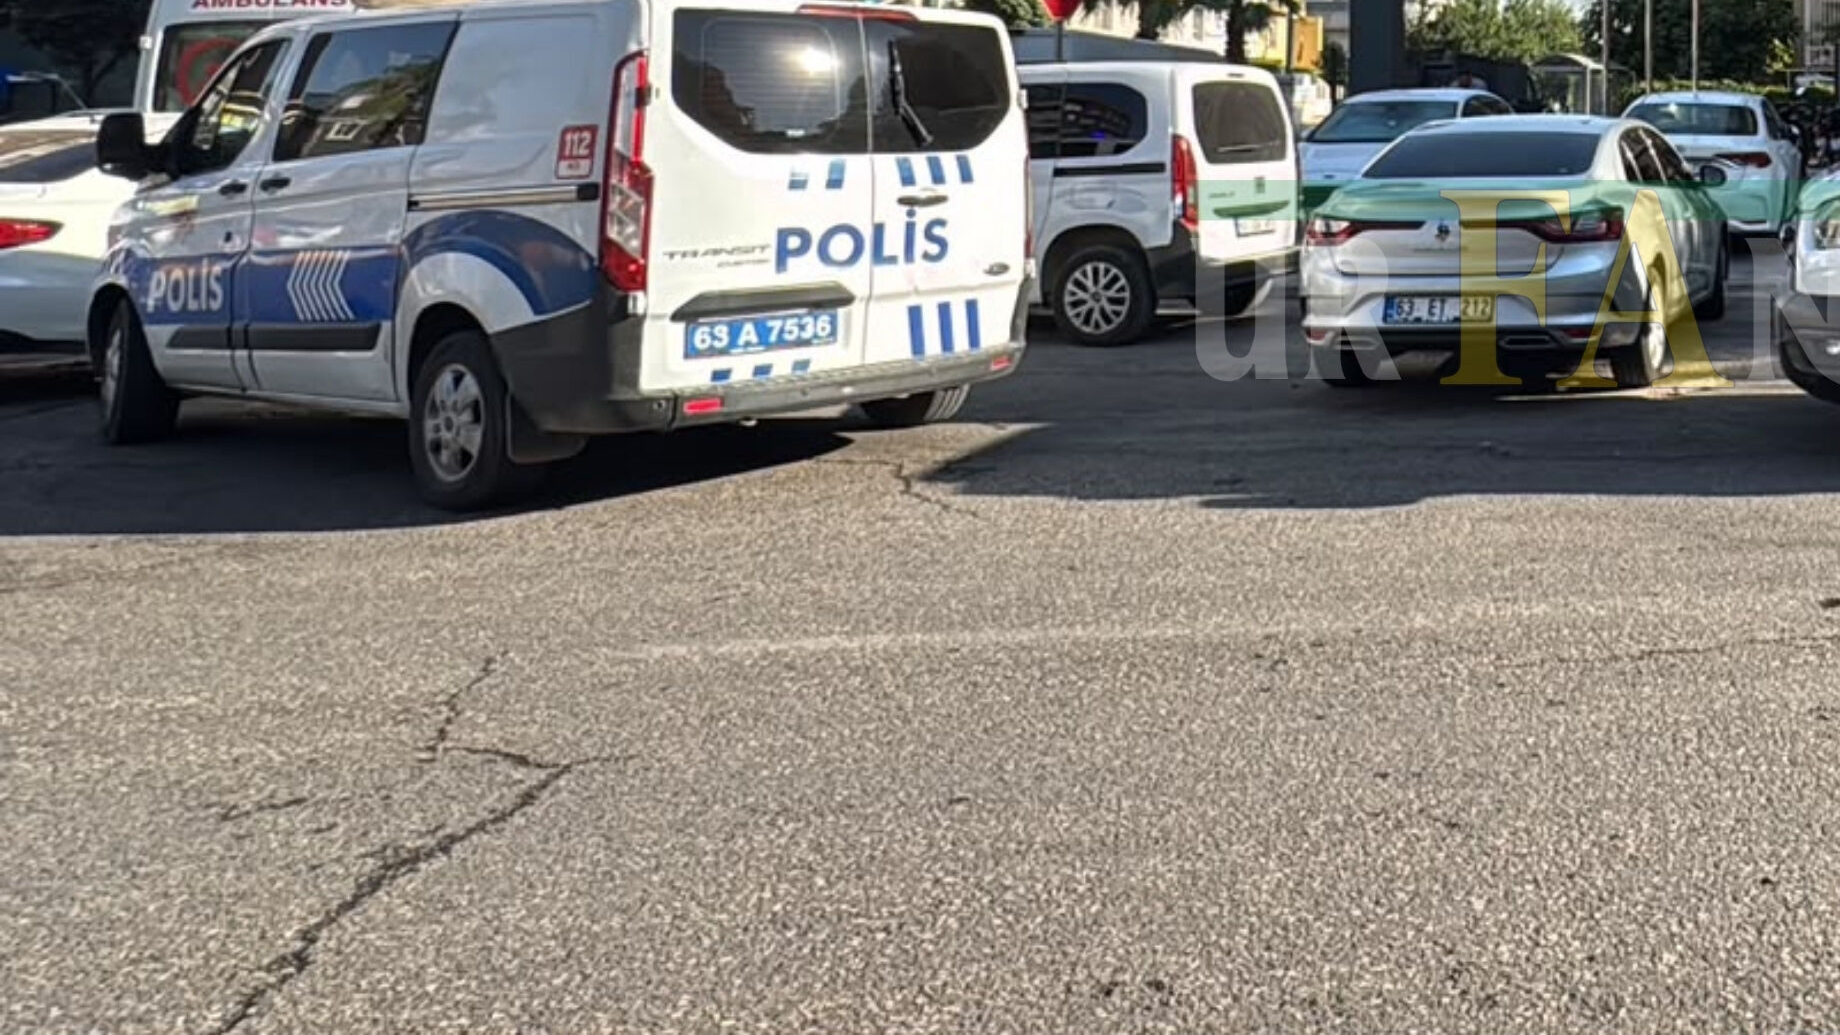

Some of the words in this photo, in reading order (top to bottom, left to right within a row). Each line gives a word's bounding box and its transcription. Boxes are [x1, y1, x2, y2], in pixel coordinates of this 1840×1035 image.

[565, 131, 592, 156] 112
[775, 208, 950, 274] POLİS
[1396, 297, 1415, 317] 63
[1462, 296, 1490, 317] 212
[693, 326, 730, 350] 63
[737, 321, 759, 346] A
[766, 314, 833, 343] 7536
